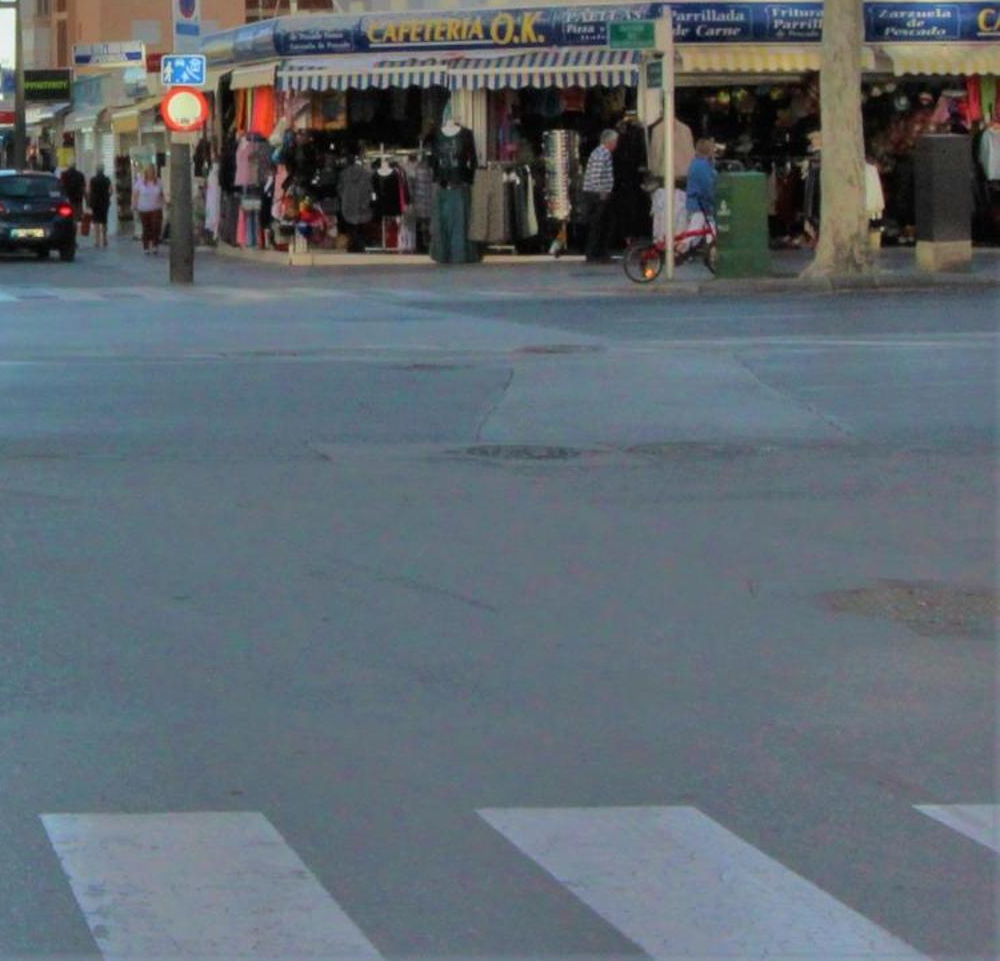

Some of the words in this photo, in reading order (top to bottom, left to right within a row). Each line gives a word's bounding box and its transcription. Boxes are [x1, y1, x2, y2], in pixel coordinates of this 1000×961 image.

[878, 8, 952, 18] Zarzuela
[366, 16, 485, 43] CAFETERIA
[490, 11, 545, 45] O.K.
[774, 19, 824, 29] Parrill
[906, 18, 925, 28] de
[567, 24, 595, 34] Pizza
[695, 24, 742, 37] Carne
[884, 26, 947, 37] Pescado
